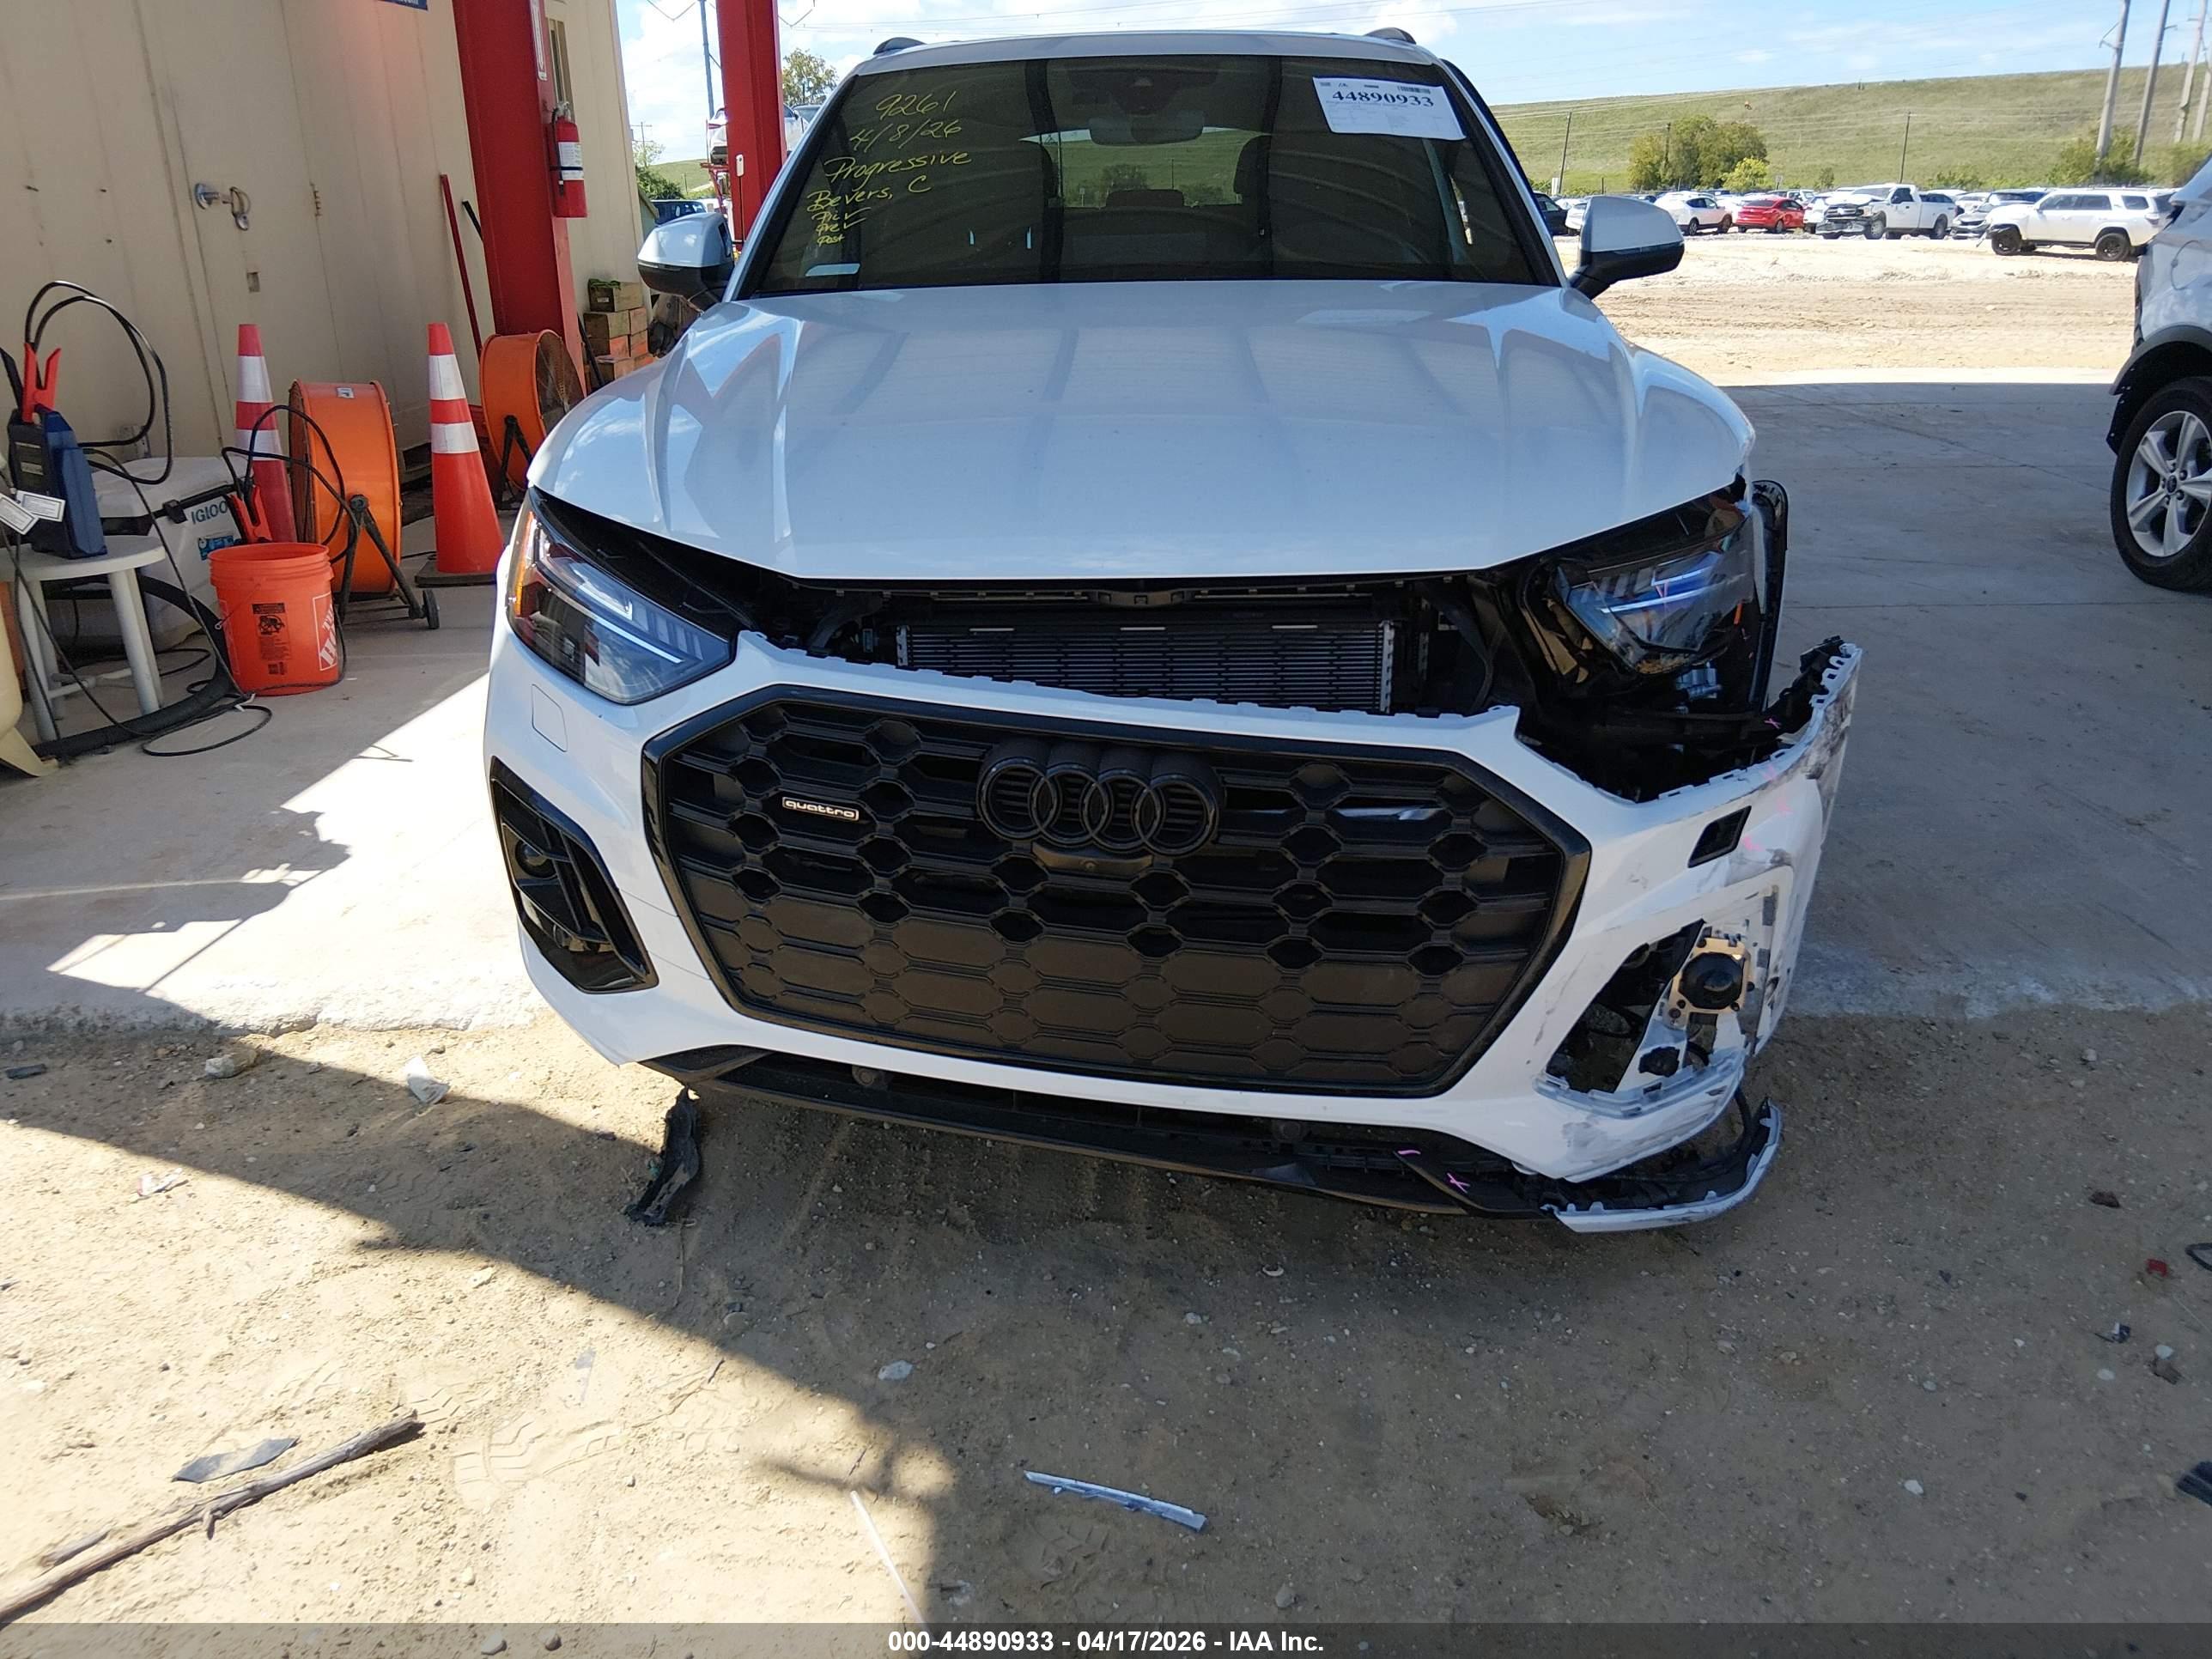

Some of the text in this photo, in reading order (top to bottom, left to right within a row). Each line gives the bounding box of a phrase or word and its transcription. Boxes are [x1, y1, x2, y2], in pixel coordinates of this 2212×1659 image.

[876, 91, 957, 120] 9261
[1332, 90, 1434, 107] 44890933
[849, 118, 963, 153] 4/8/26
[824, 150, 972, 192] Progressive
[908, 175, 932, 194] C
[191, 501, 228, 525] IGLOO
[785, 799, 854, 818] quattro
